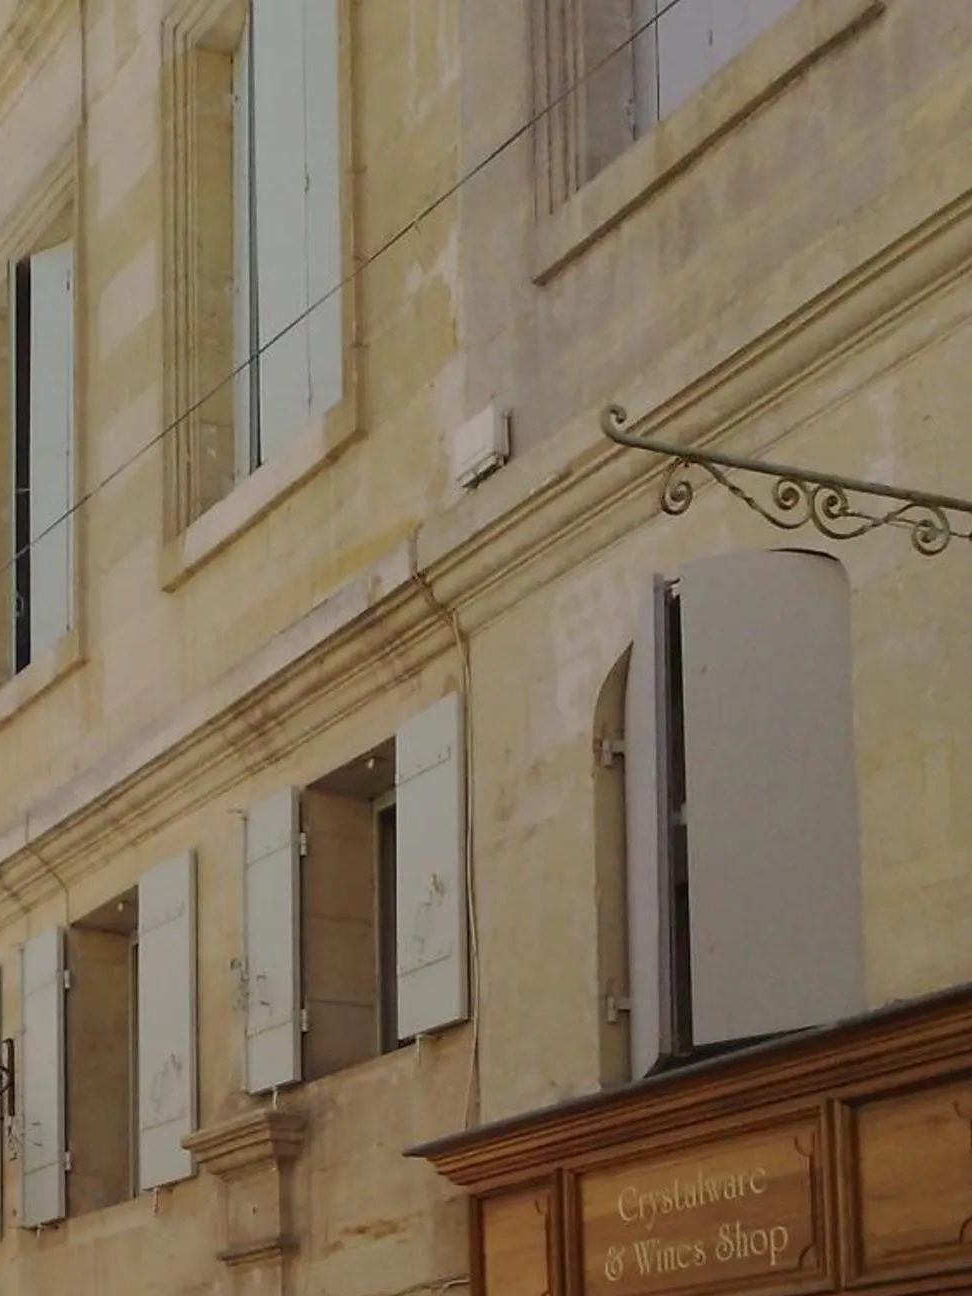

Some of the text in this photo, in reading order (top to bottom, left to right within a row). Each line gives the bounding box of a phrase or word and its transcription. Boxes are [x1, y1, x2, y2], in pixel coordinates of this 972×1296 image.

[617, 1166, 767, 1231] Crystalware
[604, 1219, 789, 1283] & Wines Shop
